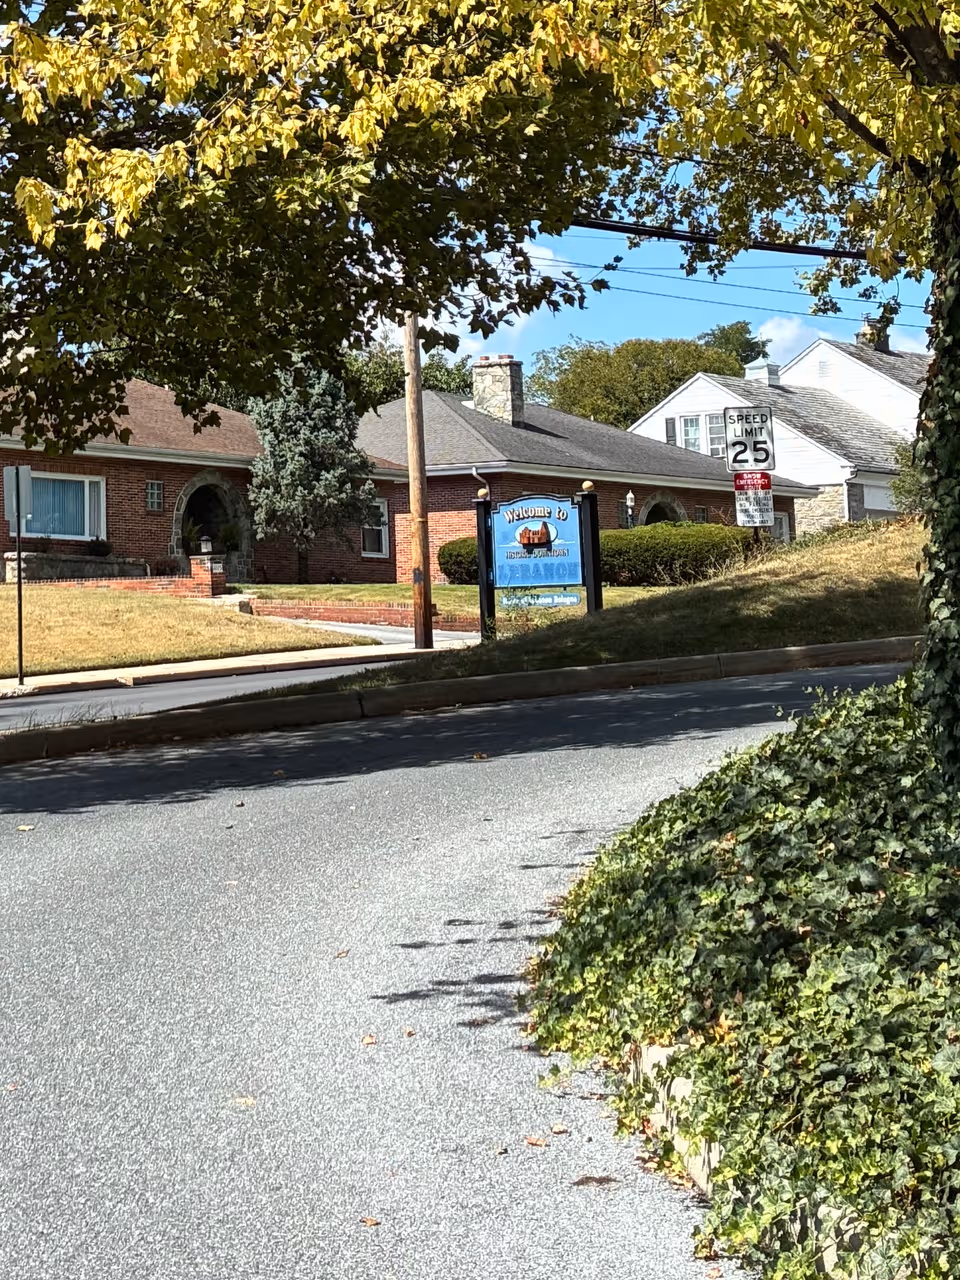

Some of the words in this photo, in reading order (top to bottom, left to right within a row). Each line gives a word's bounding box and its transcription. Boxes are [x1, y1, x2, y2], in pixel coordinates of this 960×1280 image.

[728, 414, 768, 424] SPEED
[734, 427, 764, 437] LIMIT
[732, 441, 769, 463] 25
[504, 506, 552, 523] Welcome
[556, 507, 568, 521] to
[533, 549, 570, 558] DOWNTOWN
[497, 562, 580, 580] LEBANON
